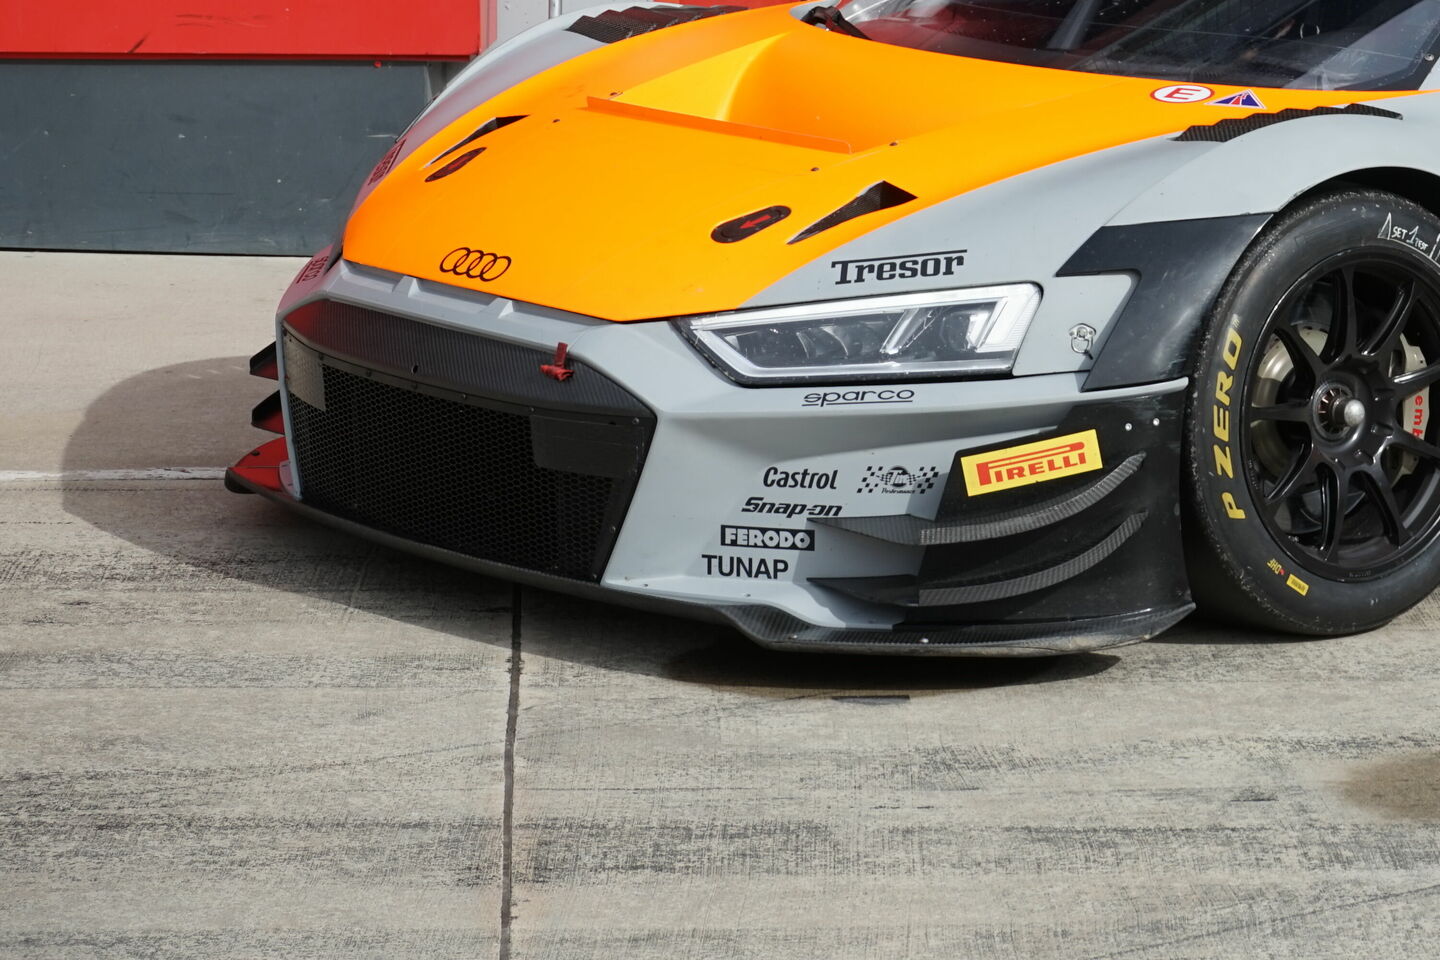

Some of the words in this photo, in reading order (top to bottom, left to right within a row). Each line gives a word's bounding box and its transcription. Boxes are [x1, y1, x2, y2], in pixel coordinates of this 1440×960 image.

[1164, 88, 1202, 100] E
[1392, 226, 1408, 239] SET
[831, 249, 967, 285] Tresor
[803, 389, 915, 408] sparco
[1213, 328, 1243, 479] ZERO
[976, 441, 1086, 486] PIRELLI
[763, 466, 838, 489] Castrol
[741, 497, 842, 518] Snap-on
[1220, 492, 1247, 520] P
[724, 527, 811, 550] FERODO
[701, 554, 789, 580] TUNAP
